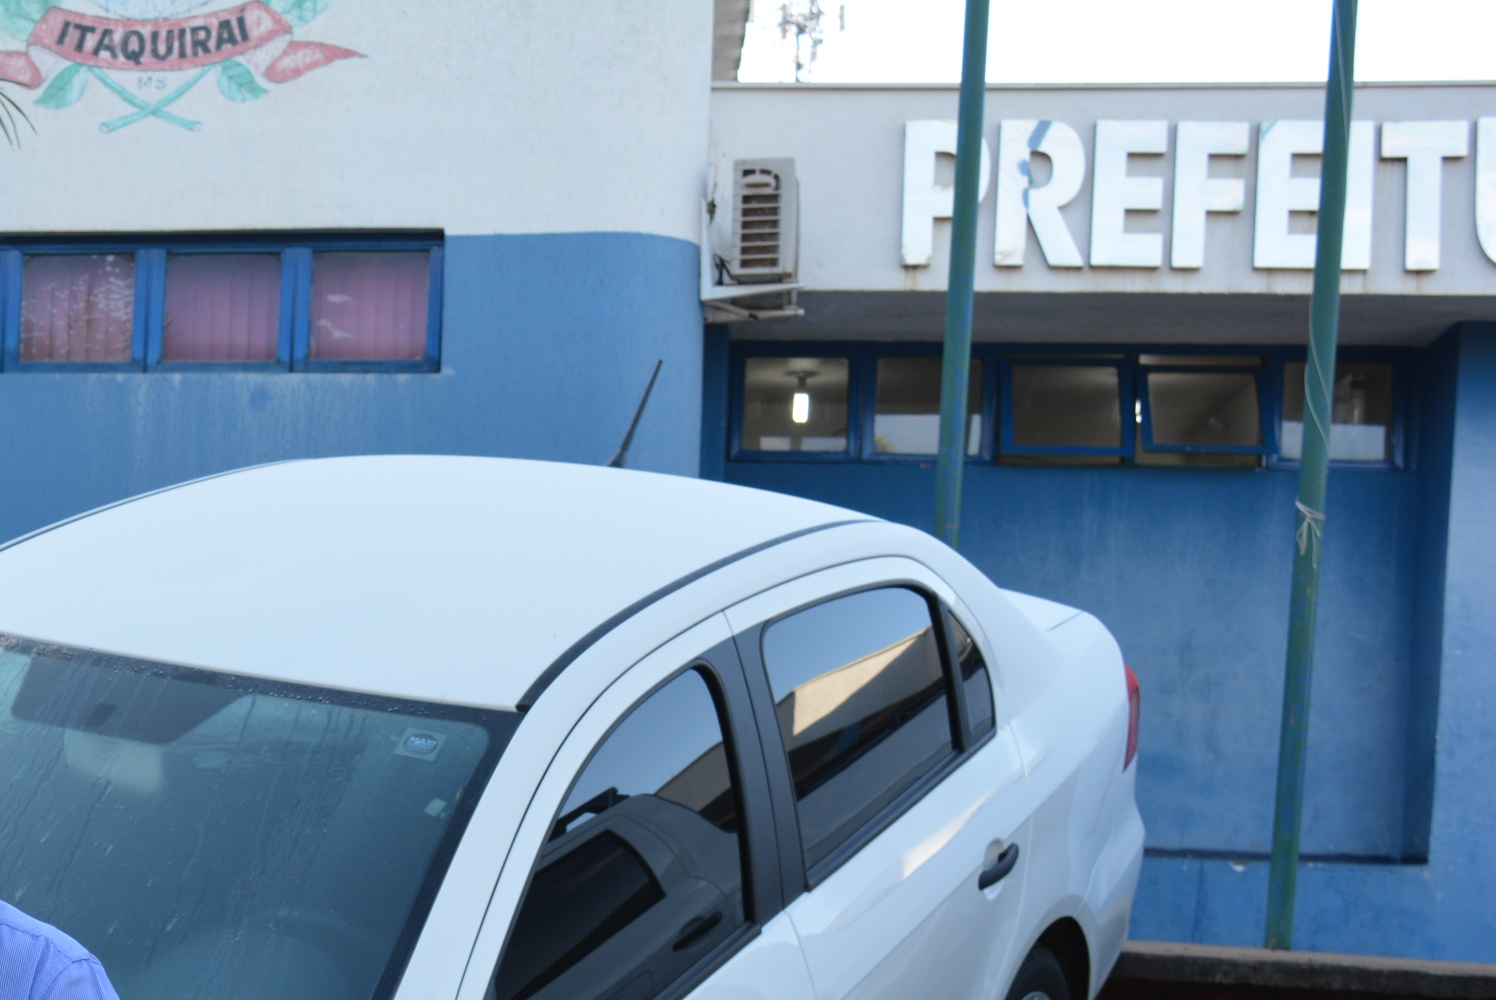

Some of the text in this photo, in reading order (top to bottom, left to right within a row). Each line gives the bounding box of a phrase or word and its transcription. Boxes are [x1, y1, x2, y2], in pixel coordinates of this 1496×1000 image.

[56, 8, 250, 65] ITAQUIRAÍ
[138, 77, 167, 90] MS
[900, 117, 1496, 273] PREFEIT
